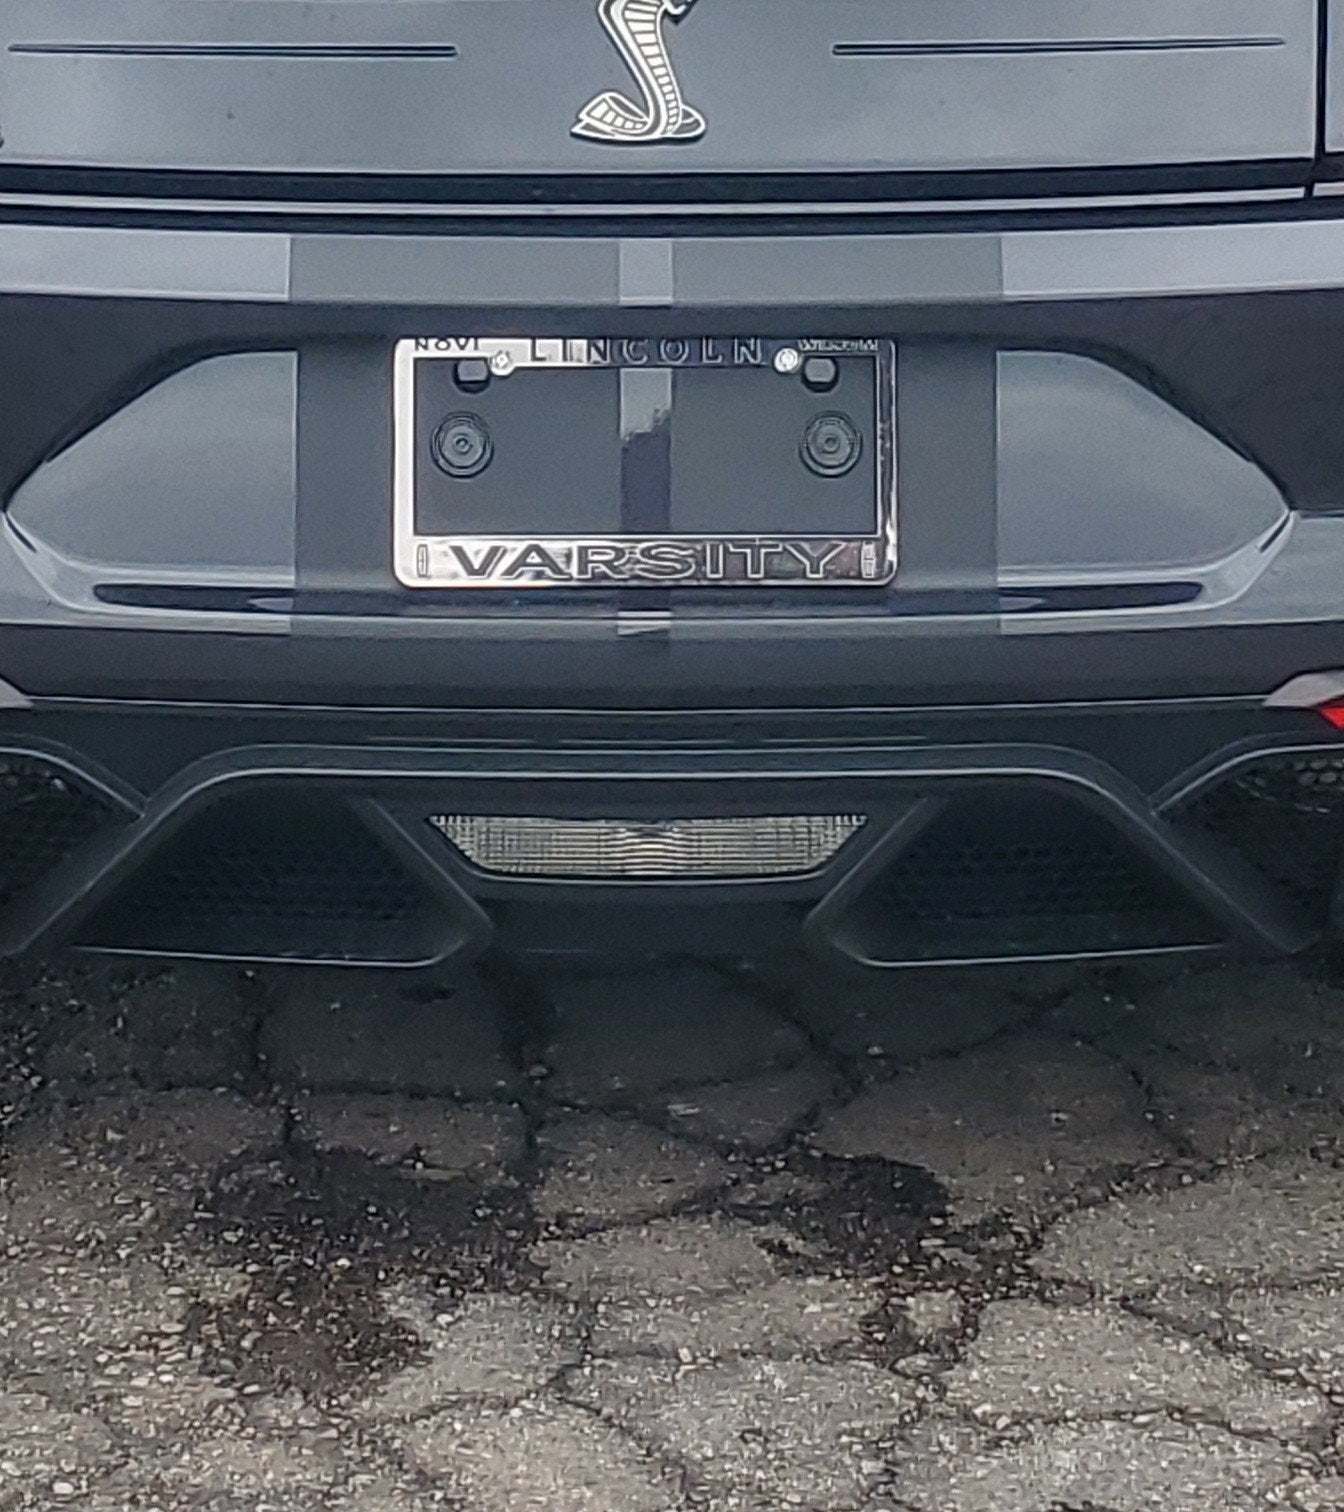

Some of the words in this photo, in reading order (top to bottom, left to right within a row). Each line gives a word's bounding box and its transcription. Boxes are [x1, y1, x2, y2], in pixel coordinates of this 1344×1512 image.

[415, 336, 479, 351] NOVI
[530, 337, 762, 364] LINCOLN
[451, 542, 847, 580] VARSITY
